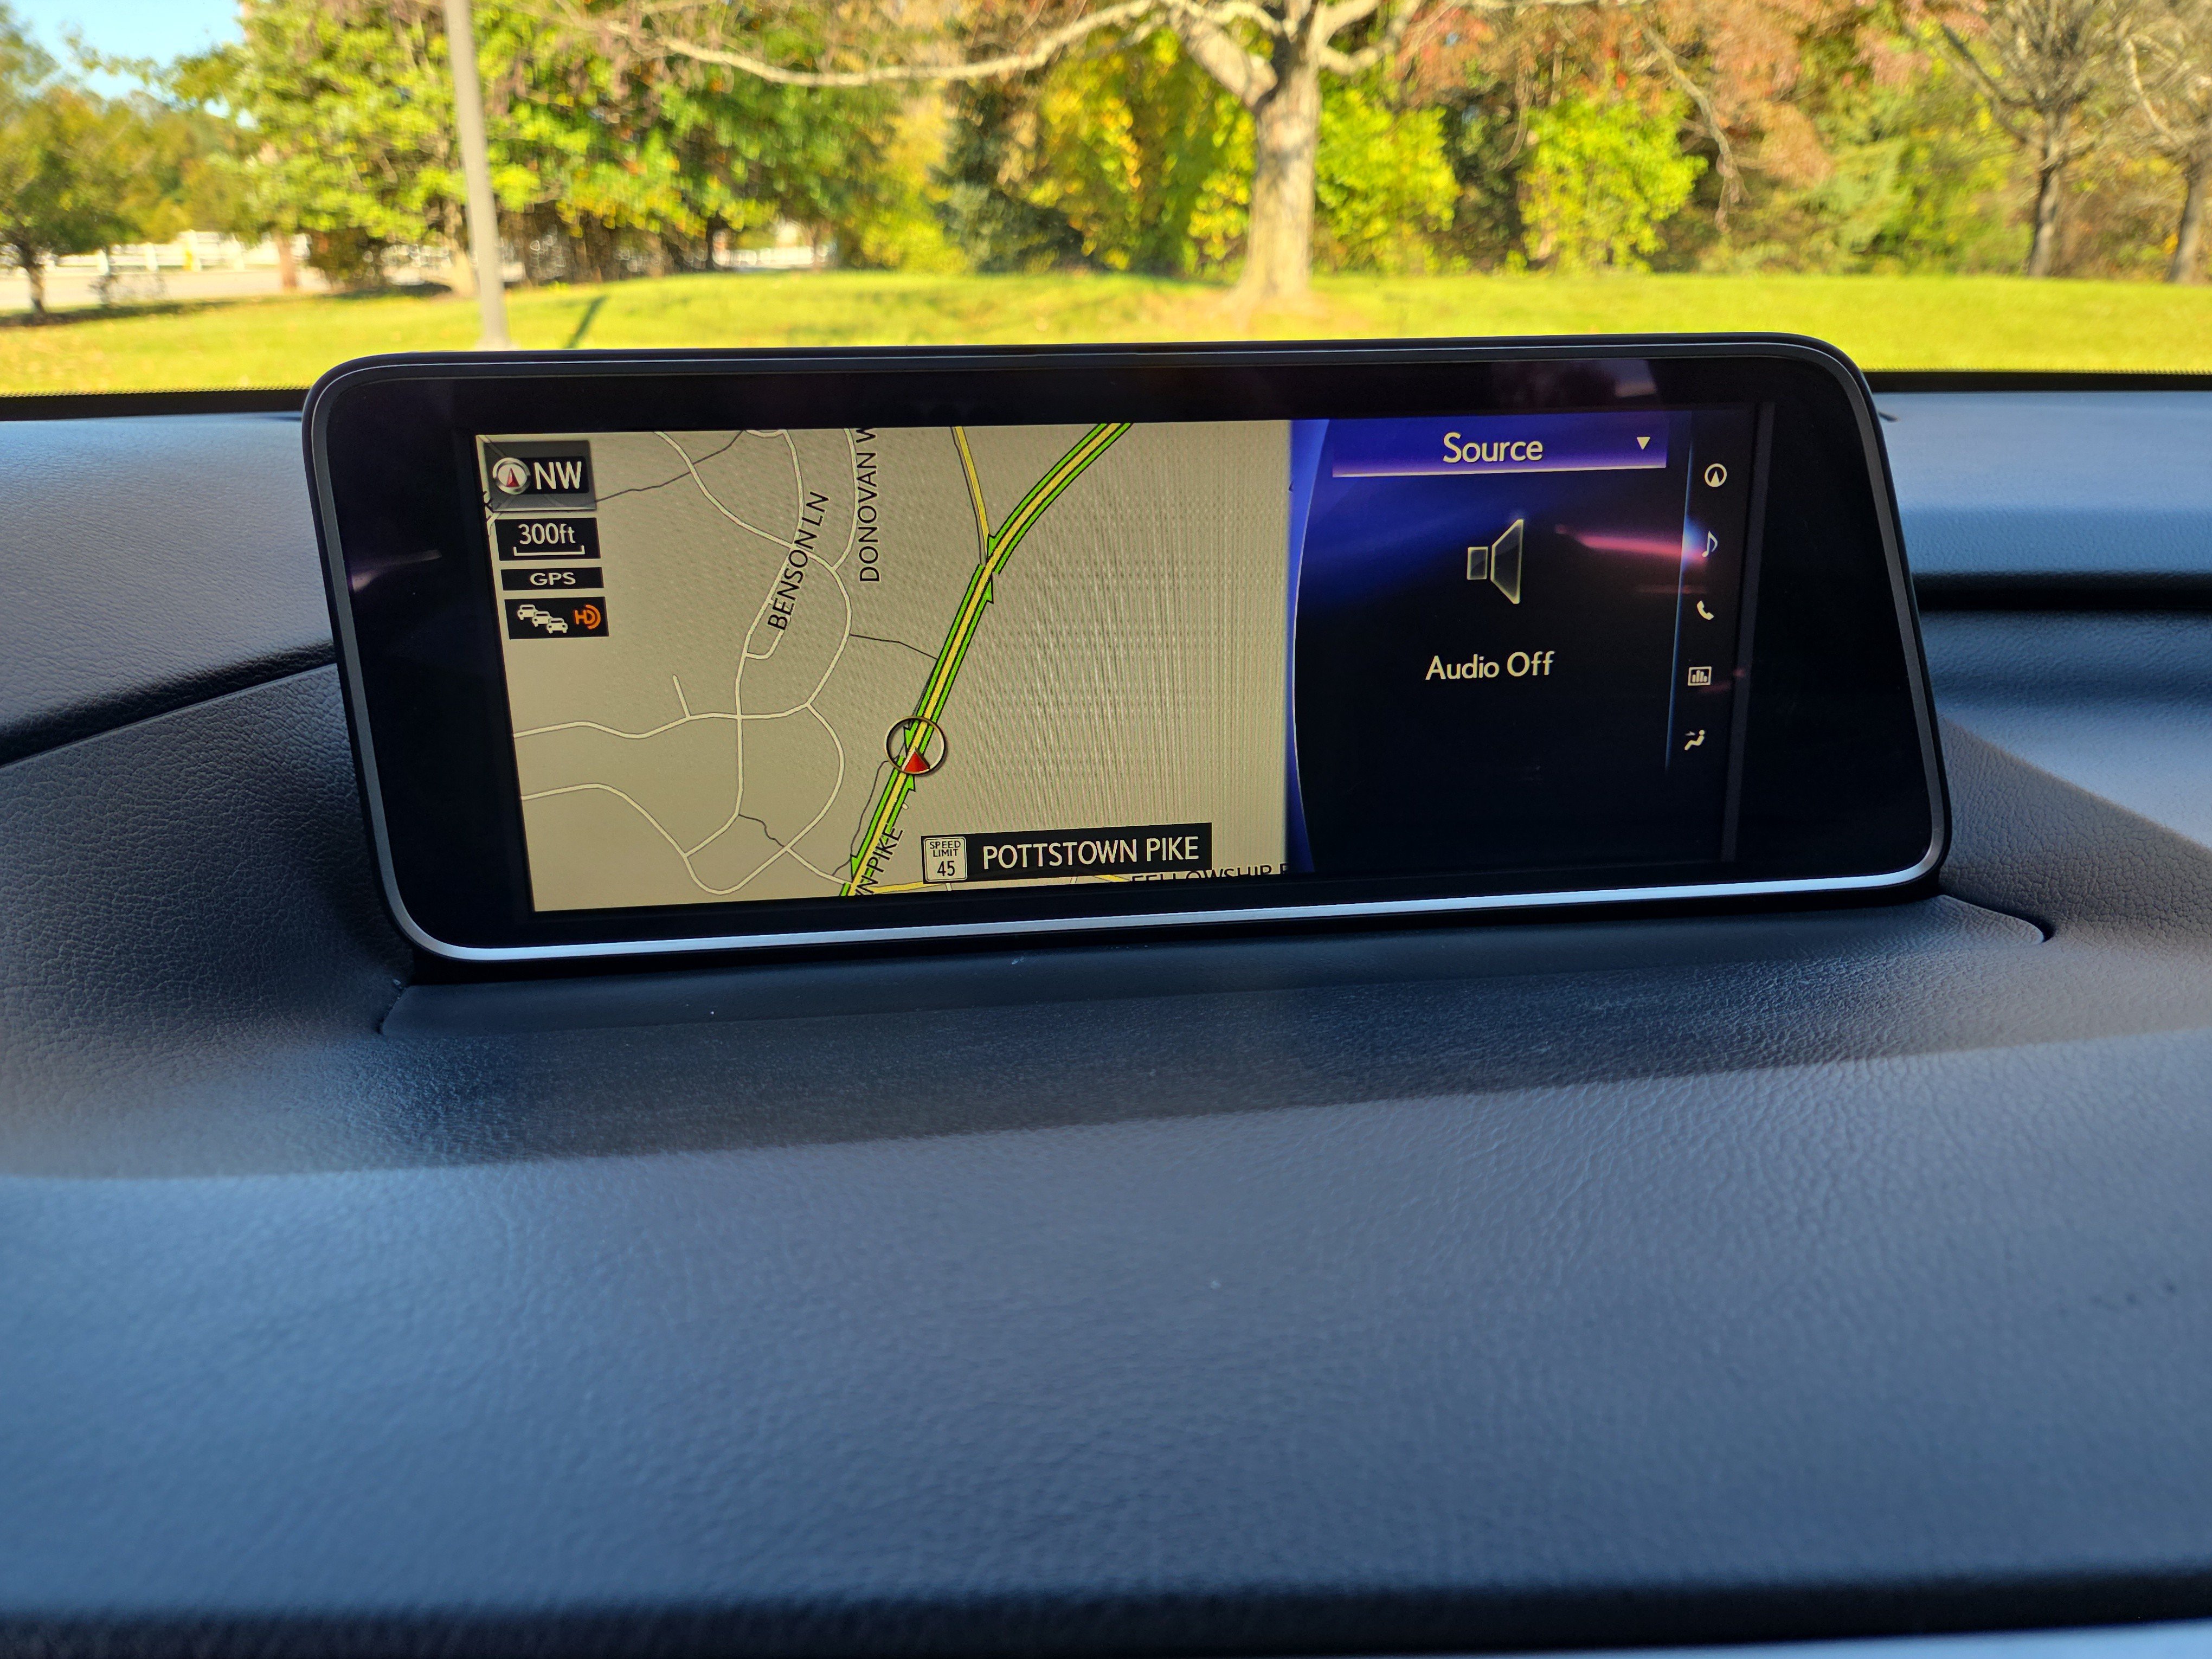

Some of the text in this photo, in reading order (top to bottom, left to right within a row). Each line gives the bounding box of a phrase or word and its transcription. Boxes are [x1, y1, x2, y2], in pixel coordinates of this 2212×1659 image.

[1443, 432, 1543, 463] Source
[534, 461, 582, 490] NW
[856, 452, 880, 582] DONOVAN
[517, 523, 576, 545] 300ft
[767, 492, 829, 631] BENSON LN
[530, 572, 576, 586] GPS
[1425, 650, 1555, 680] Audio Off
[866, 824, 904, 873] PIKE
[929, 840, 961, 850] SPEED
[933, 848, 959, 857] LIMIT
[983, 835, 1199, 870] POTTSTOWN PIKE
[936, 860, 956, 877] 45
